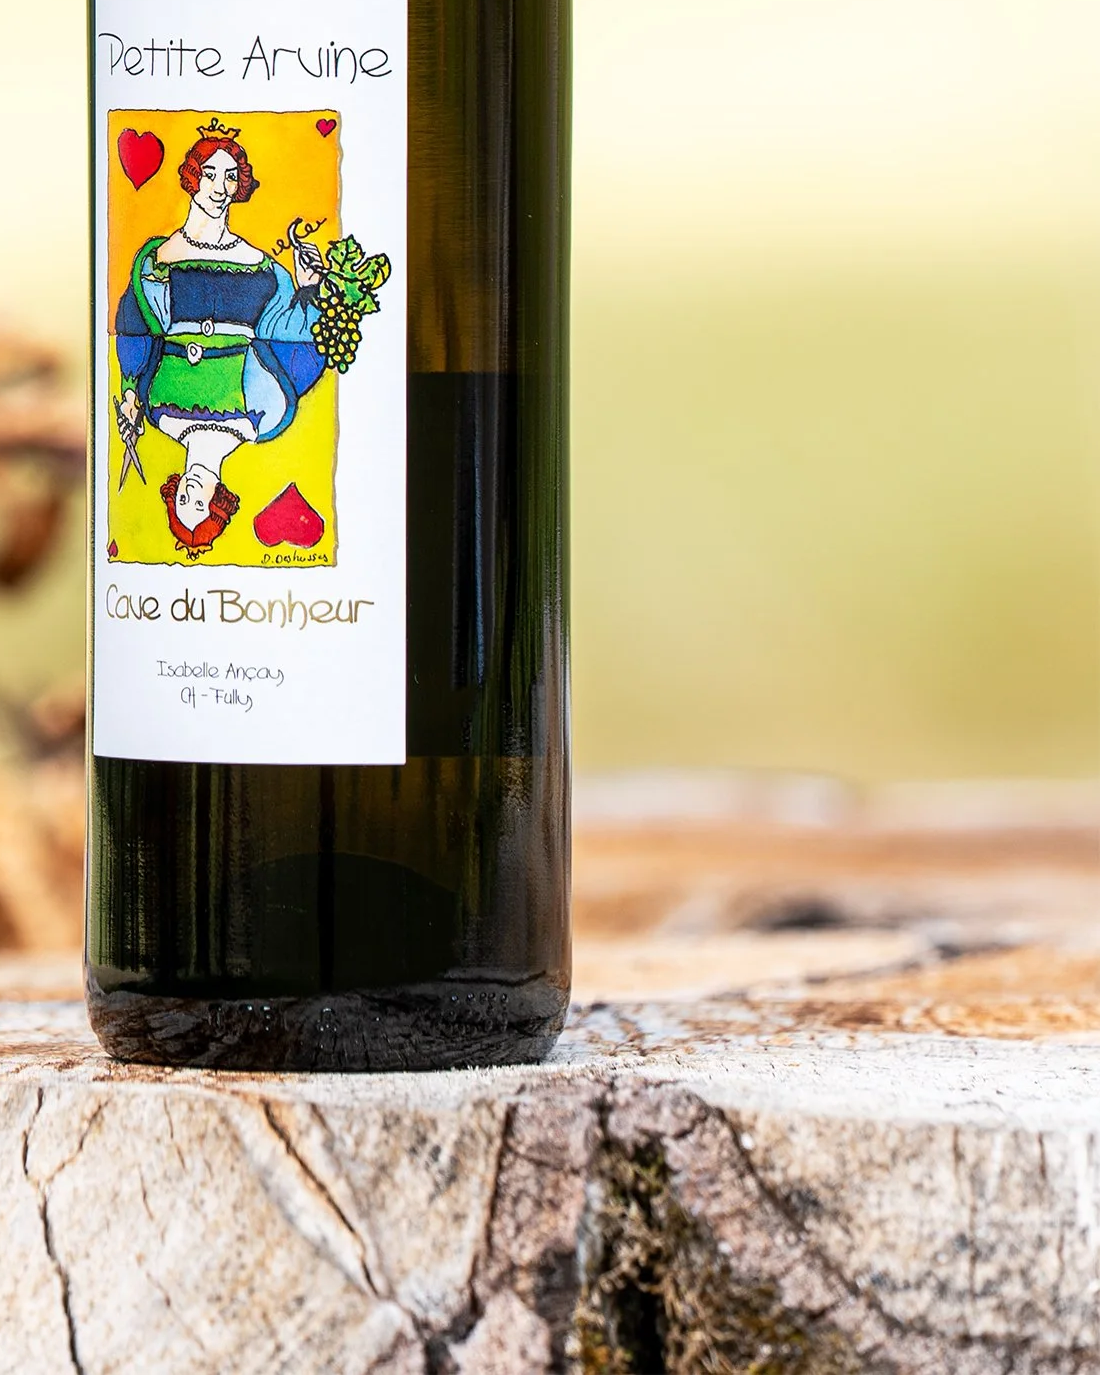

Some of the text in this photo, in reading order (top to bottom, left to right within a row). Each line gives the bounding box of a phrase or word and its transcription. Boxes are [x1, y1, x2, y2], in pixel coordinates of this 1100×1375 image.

[98, 32, 393, 84] Petite Arvine
[105, 583, 375, 631] Cave du Bonheur
[156, 660, 285, 687] Isabelle Ançay
[209, 686, 253, 713] Fully
